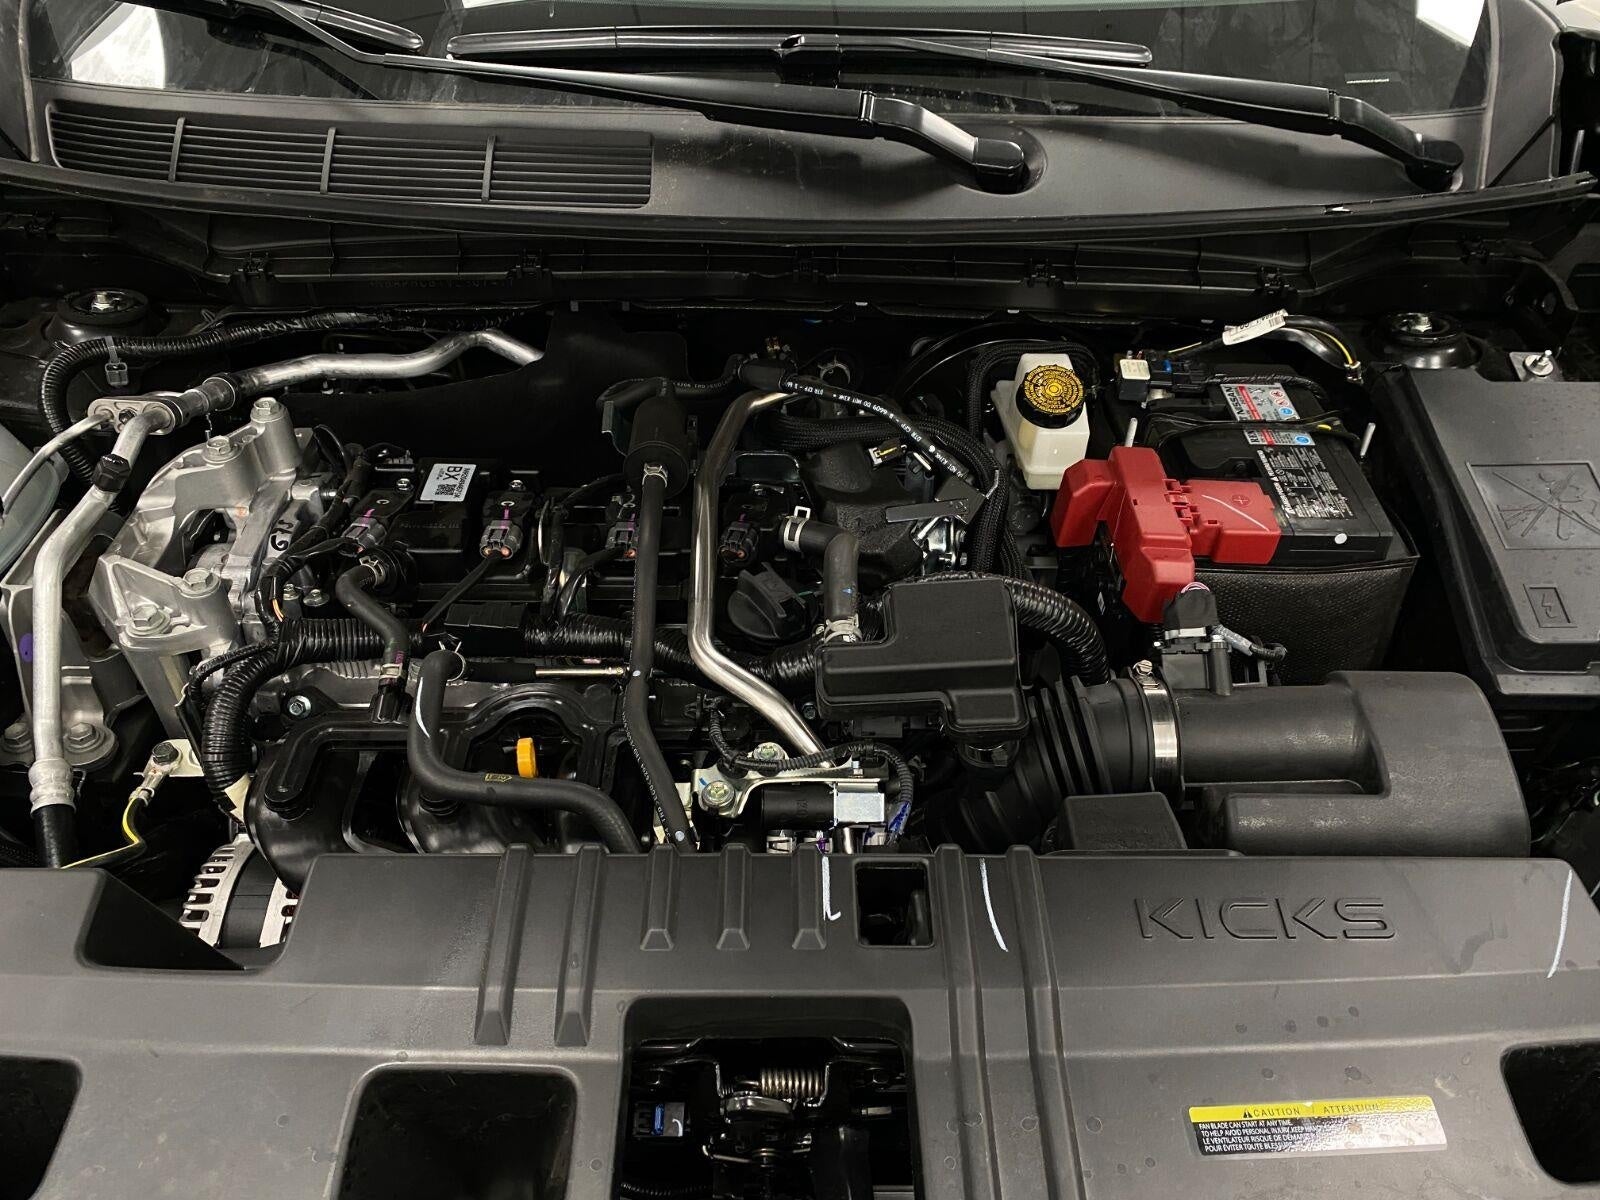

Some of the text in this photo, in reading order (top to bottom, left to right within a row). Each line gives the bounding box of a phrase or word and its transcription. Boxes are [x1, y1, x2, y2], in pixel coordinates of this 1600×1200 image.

[1224, 386, 1245, 415] NISSAN
[443, 465, 463, 480] BX
[1134, 897, 1395, 939] KICKS
[1253, 1106, 1300, 1117] CAUTION
[1210, 1122, 1228, 1130] BLADE
[1229, 1121, 1240, 1129] CAN
[1242, 1128, 1270, 1136] PERSONAL
[1210, 1136, 1250, 1144] VENTILATEUR
[1250, 1135, 1272, 1143] RISQUE
